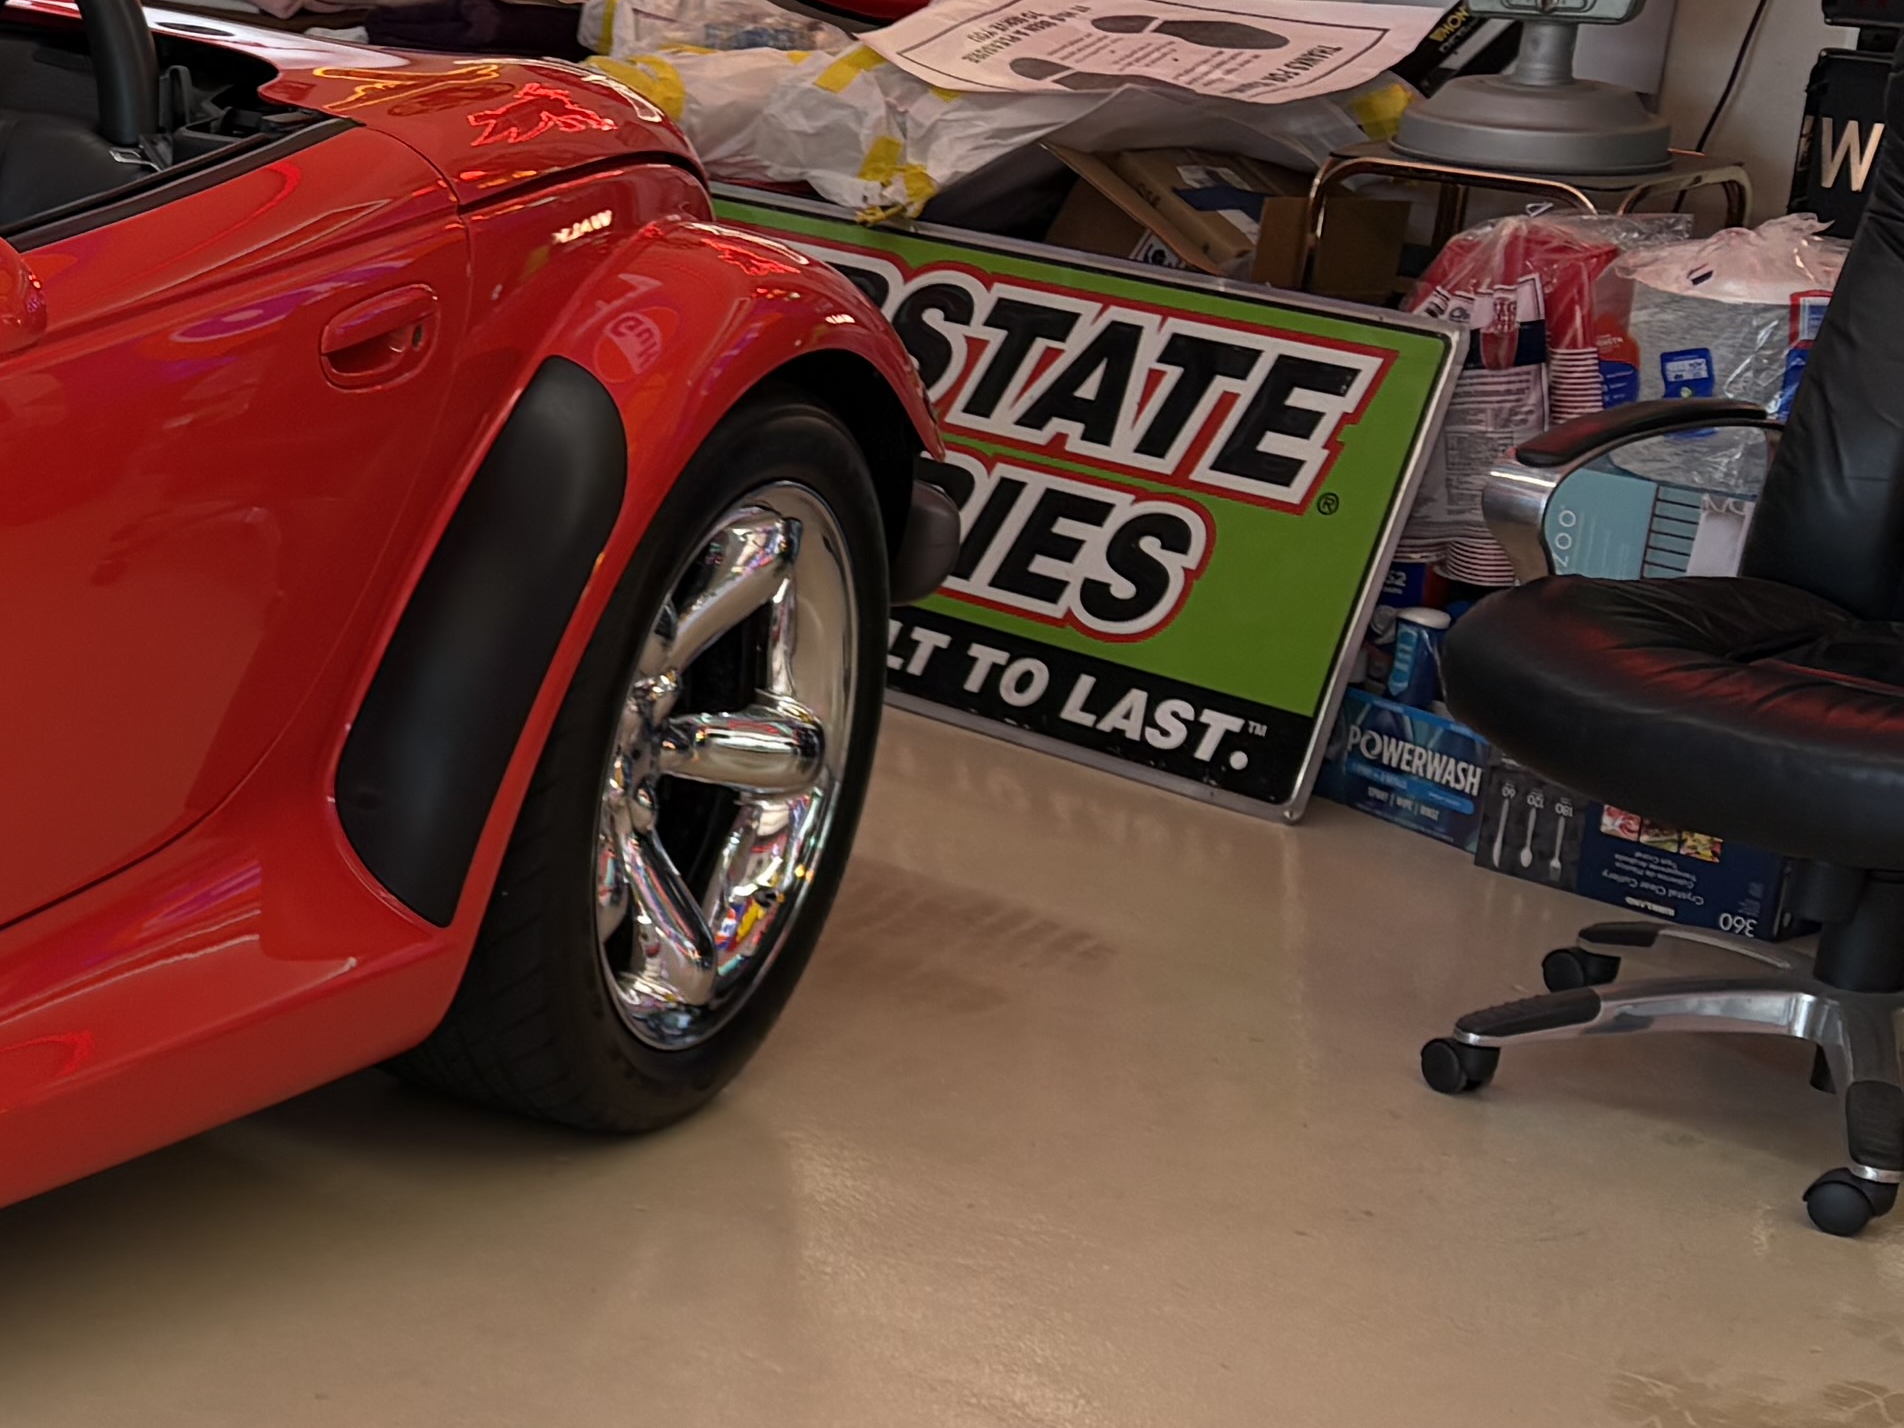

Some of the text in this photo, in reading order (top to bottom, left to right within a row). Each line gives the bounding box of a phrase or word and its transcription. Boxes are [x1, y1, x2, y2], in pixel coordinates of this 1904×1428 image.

[832, 264, 1364, 488] STATE
[964, 643, 1050, 709] TO
[1061, 681, 1250, 770] LAST.
[1348, 725, 1482, 797] POWERWASH
[1718, 911, 1759, 939] 360
